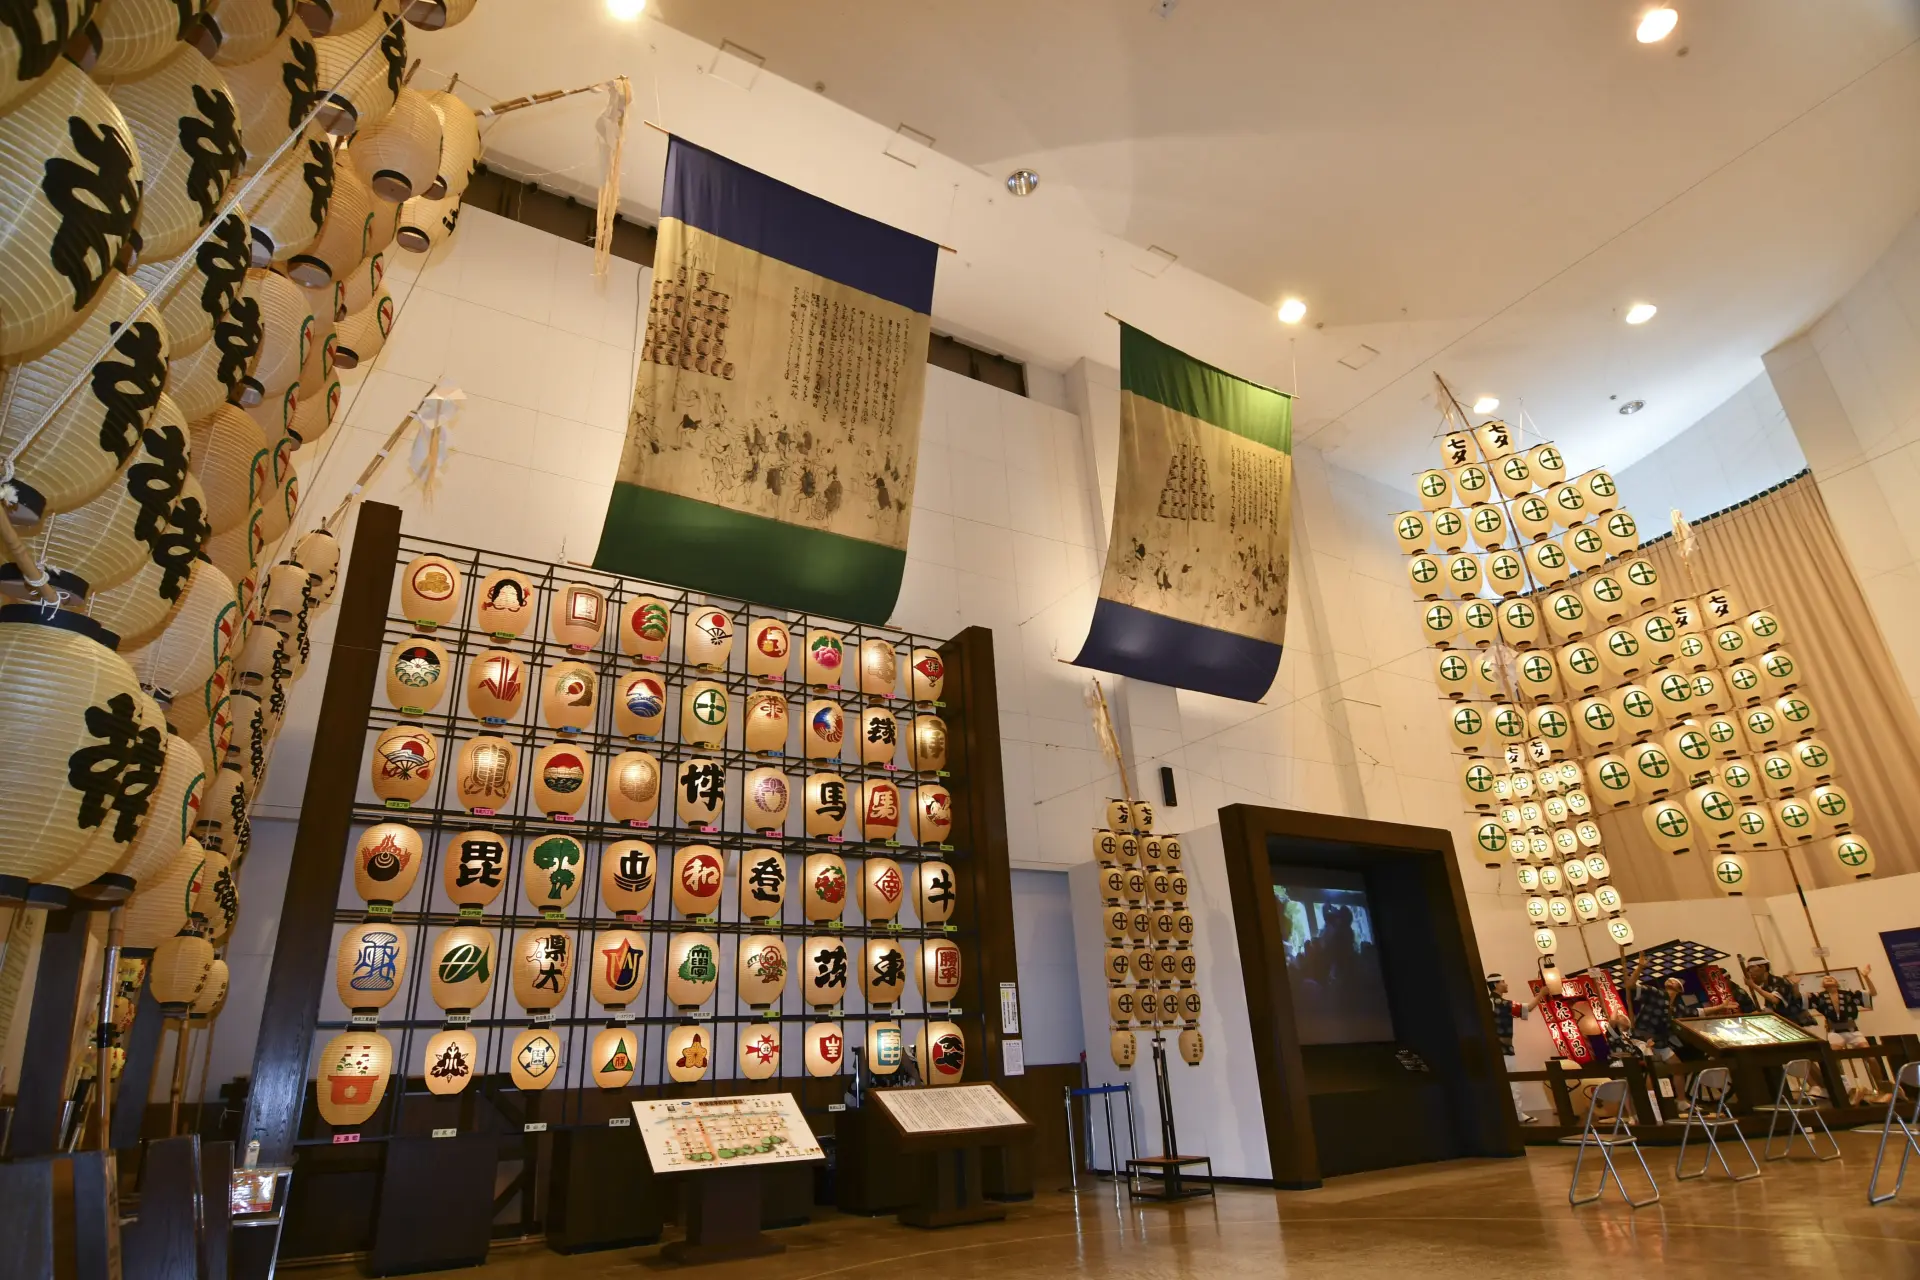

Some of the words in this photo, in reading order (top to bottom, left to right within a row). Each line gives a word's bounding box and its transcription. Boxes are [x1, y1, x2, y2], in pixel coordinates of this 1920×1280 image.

[1488, 424, 1509, 448] 七夕
[1447, 439, 1467, 465] 七夕
[1671, 606, 1689, 628] 七夕
[1708, 596, 1729, 618] 七夕
[1506, 747, 1519, 764] 七夕
[1531, 741, 1545, 758] 七夕
[816, 782, 847, 821] 馬
[870, 791, 897, 820] 馬
[1117, 804, 1129, 824] 七夕
[1141, 806, 1153, 825] 七夕
[456, 840, 503, 887] 毘
[684, 859, 720, 891] 和
[749, 857, 785, 903] 登
[882, 871, 900, 898] 南
[928, 869, 955, 914] 牛
[535, 935, 566, 993] 県大
[872, 949, 905, 987] 東
[939, 952, 958, 983] 勝平
[826, 1037, 840, 1058] 山王
[444, 1058, 458, 1070] 川
